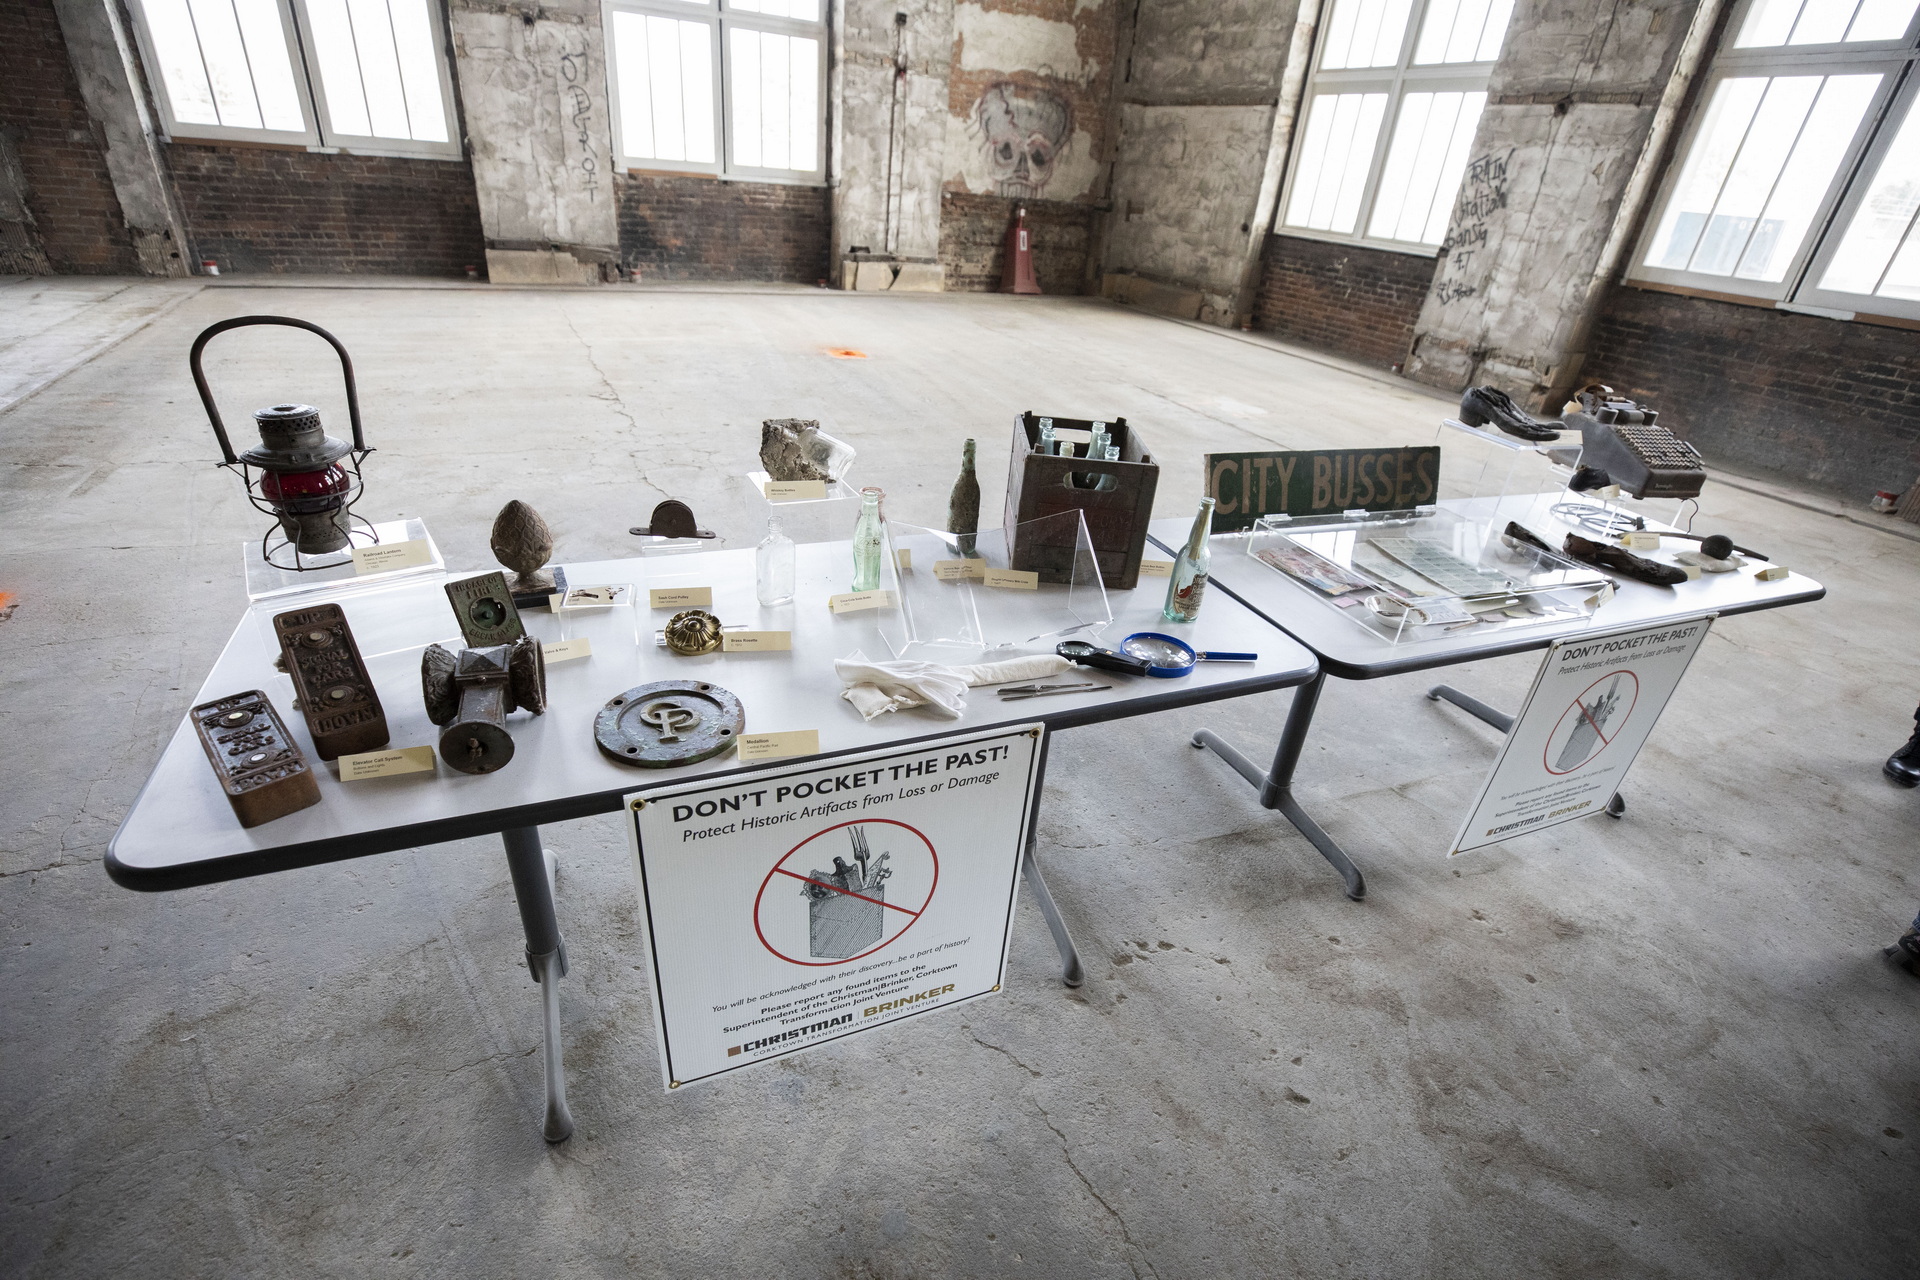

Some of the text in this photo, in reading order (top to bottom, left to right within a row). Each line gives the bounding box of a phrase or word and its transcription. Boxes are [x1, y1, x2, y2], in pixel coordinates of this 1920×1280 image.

[1211, 452, 1433, 515] CITY BUSSES
[1558, 665, 1581, 675] Protect
[1580, 659, 1603, 671] Historic
[1603, 654, 1628, 666] Artifacts
[1627, 651, 1644, 663] from
[1643, 649, 1655, 658] Loss
[1662, 644, 1686, 654] Damage
[1562, 626, 1699, 661] DON'T POCKET THE PAST!
[317, 705, 377, 732] DOWN
[672, 745, 1009, 822] DON'T POCKET THE PAST!
[683, 771, 1000, 842] Protect Historic Artifacts from Loss or Damage
[1548, 800, 1592, 818] BRINKER
[712, 1005, 728, 1013] You
[730, 999, 745, 1008] will
[746, 996, 757, 1004] be
[760, 979, 817, 1000] acknowledged
[819, 975, 836, 984] with
[838, 969, 856, 979] their
[916, 948, 933, 958] part
[934, 944, 944, 952] of
[943, 937, 971, 950] history!
[722, 1008, 798, 1034] Superintendent
[800, 1003, 811, 1012] of
[812, 1000, 828, 1009] the
[916, 963, 958, 979] Corktown
[761, 1002, 792, 1014] Please
[794, 993, 825, 1006] report
[827, 987, 843, 997] any
[845, 979, 871, 991] found
[873, 972, 898, 984] items
[912, 964, 926, 972] the
[863, 983, 955, 1017] BRINKER
[753, 998, 939, 1057] CORKTOWN TRANSFORMATION JOINT VENTURE
[779, 984, 909, 1026] Transformation Joint Venture
